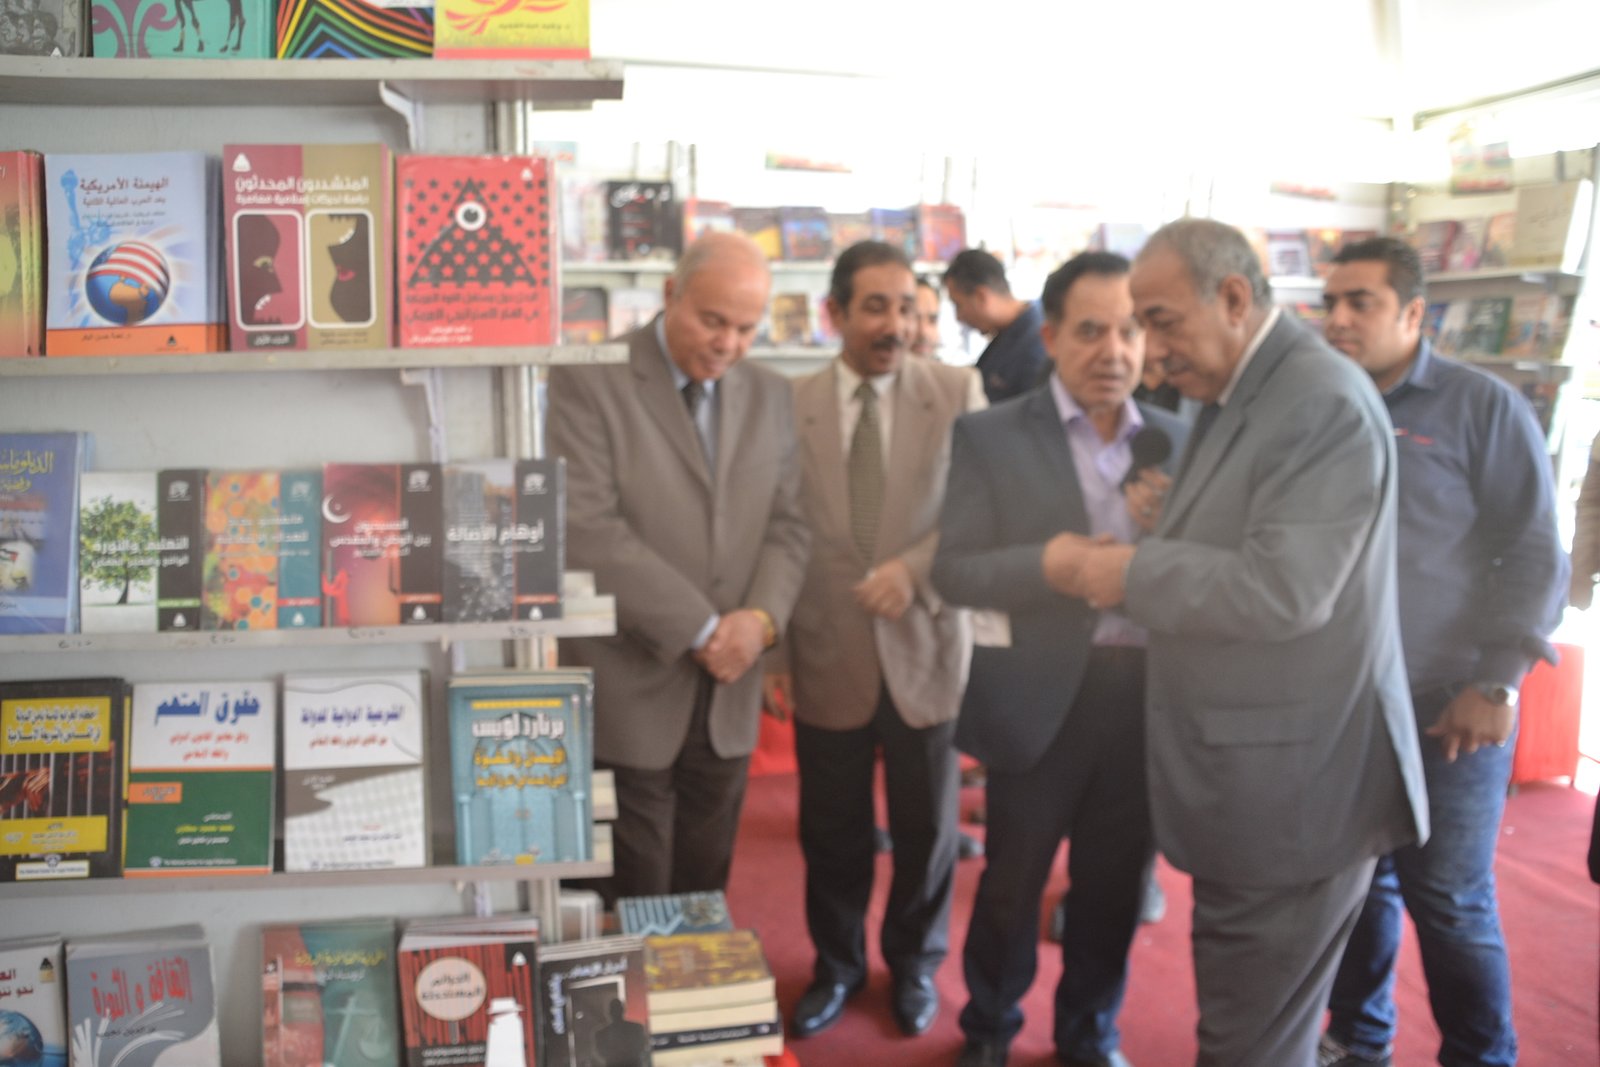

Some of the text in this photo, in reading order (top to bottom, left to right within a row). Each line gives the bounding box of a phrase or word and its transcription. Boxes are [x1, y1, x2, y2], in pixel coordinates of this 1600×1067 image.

[80, 177, 169, 194] الهيمنة الأمريكية
[235, 174, 369, 193] المتشددون المحدثون
[446, 518, 545, 545] أوهام الأصالة
[154, 690, 260, 726] حقوق المتهم
[472, 711, 564, 741] برنارد لويس
[90, 966, 133, 1022] الثورة
[146, 955, 193, 1004] الثقافة
